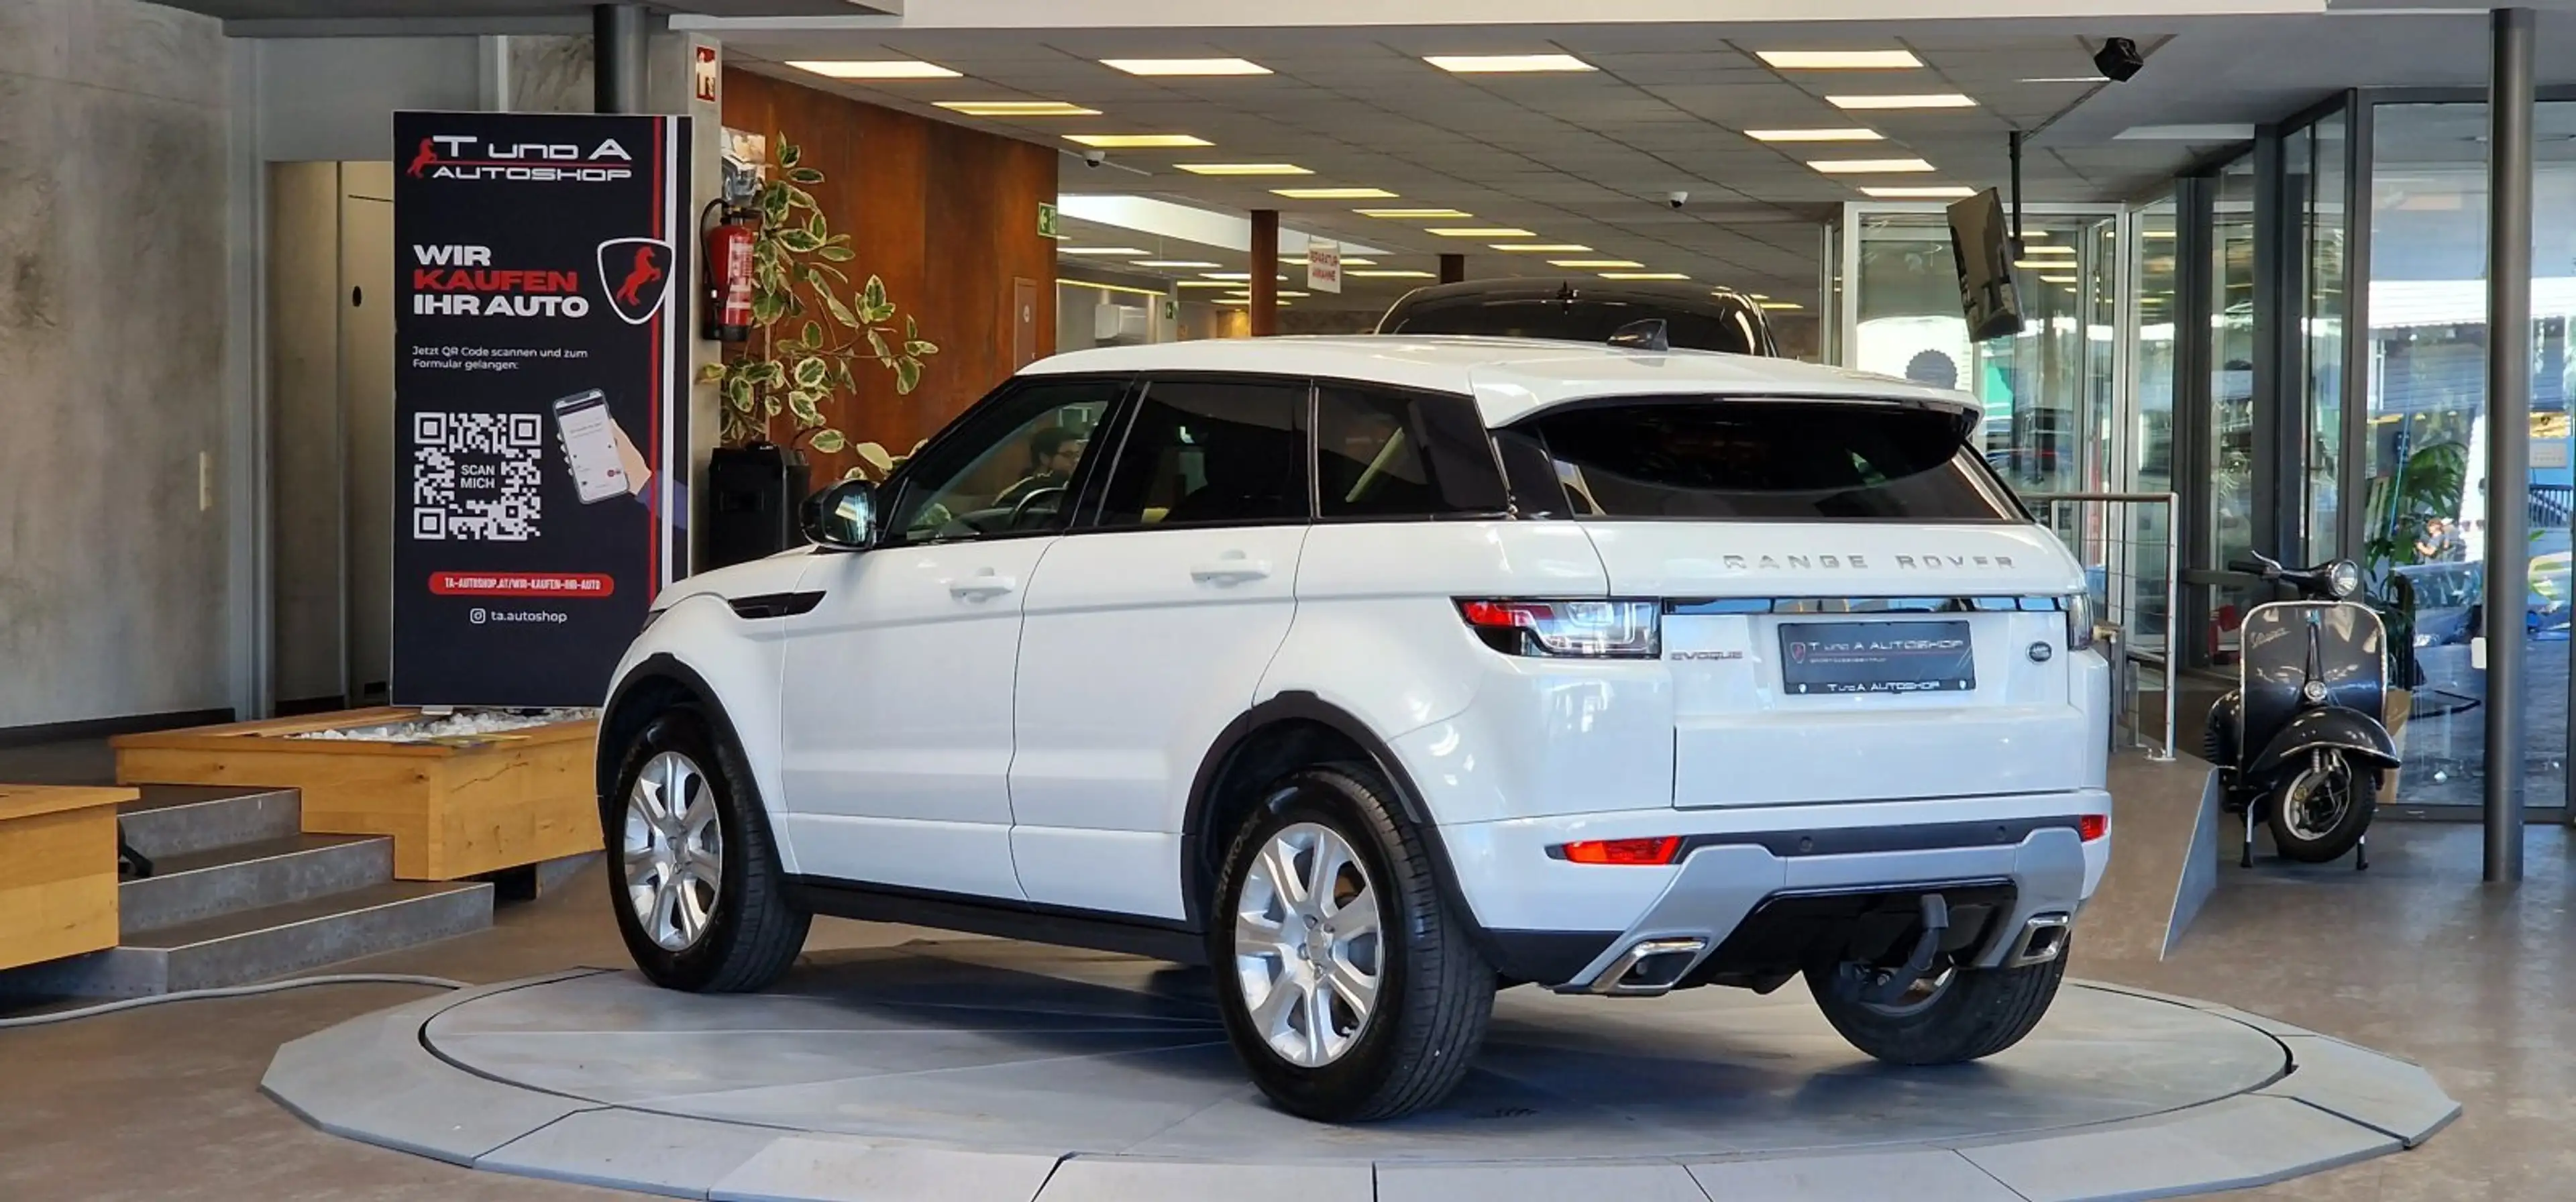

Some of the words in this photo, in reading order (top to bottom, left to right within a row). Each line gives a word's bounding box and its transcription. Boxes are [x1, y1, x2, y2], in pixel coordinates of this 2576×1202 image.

[433, 135, 477, 157] T
[588, 138, 632, 160] A
[433, 166, 632, 181] AUTOSHOP
[413, 244, 492, 266] WIR
[413, 269, 578, 292] KAUFEN
[413, 294, 480, 315] IHR
[484, 296, 589, 318] AUTO
[412, 346, 439, 356] Jetzt
[441, 346, 458, 357] QR
[461, 347, 489, 357] Code
[491, 347, 537, 357] scannen
[540, 348, 561, 358] und
[564, 349, 588, 358] zum
[413, 359, 462, 368] Formular
[460, 464, 496, 476] SCAN
[460, 477, 495, 488] MICH
[1723, 554, 1869, 570] RANGE
[1894, 554, 2017, 570] ROVER
[491, 610, 568, 624] ta.autoshop
[1808, 641, 1820, 651] T
[1854, 641, 1865, 650] A
[1869, 639, 1964, 650] AUTOSHOP
[1870, 680, 1940, 691] AUTOSHOP
